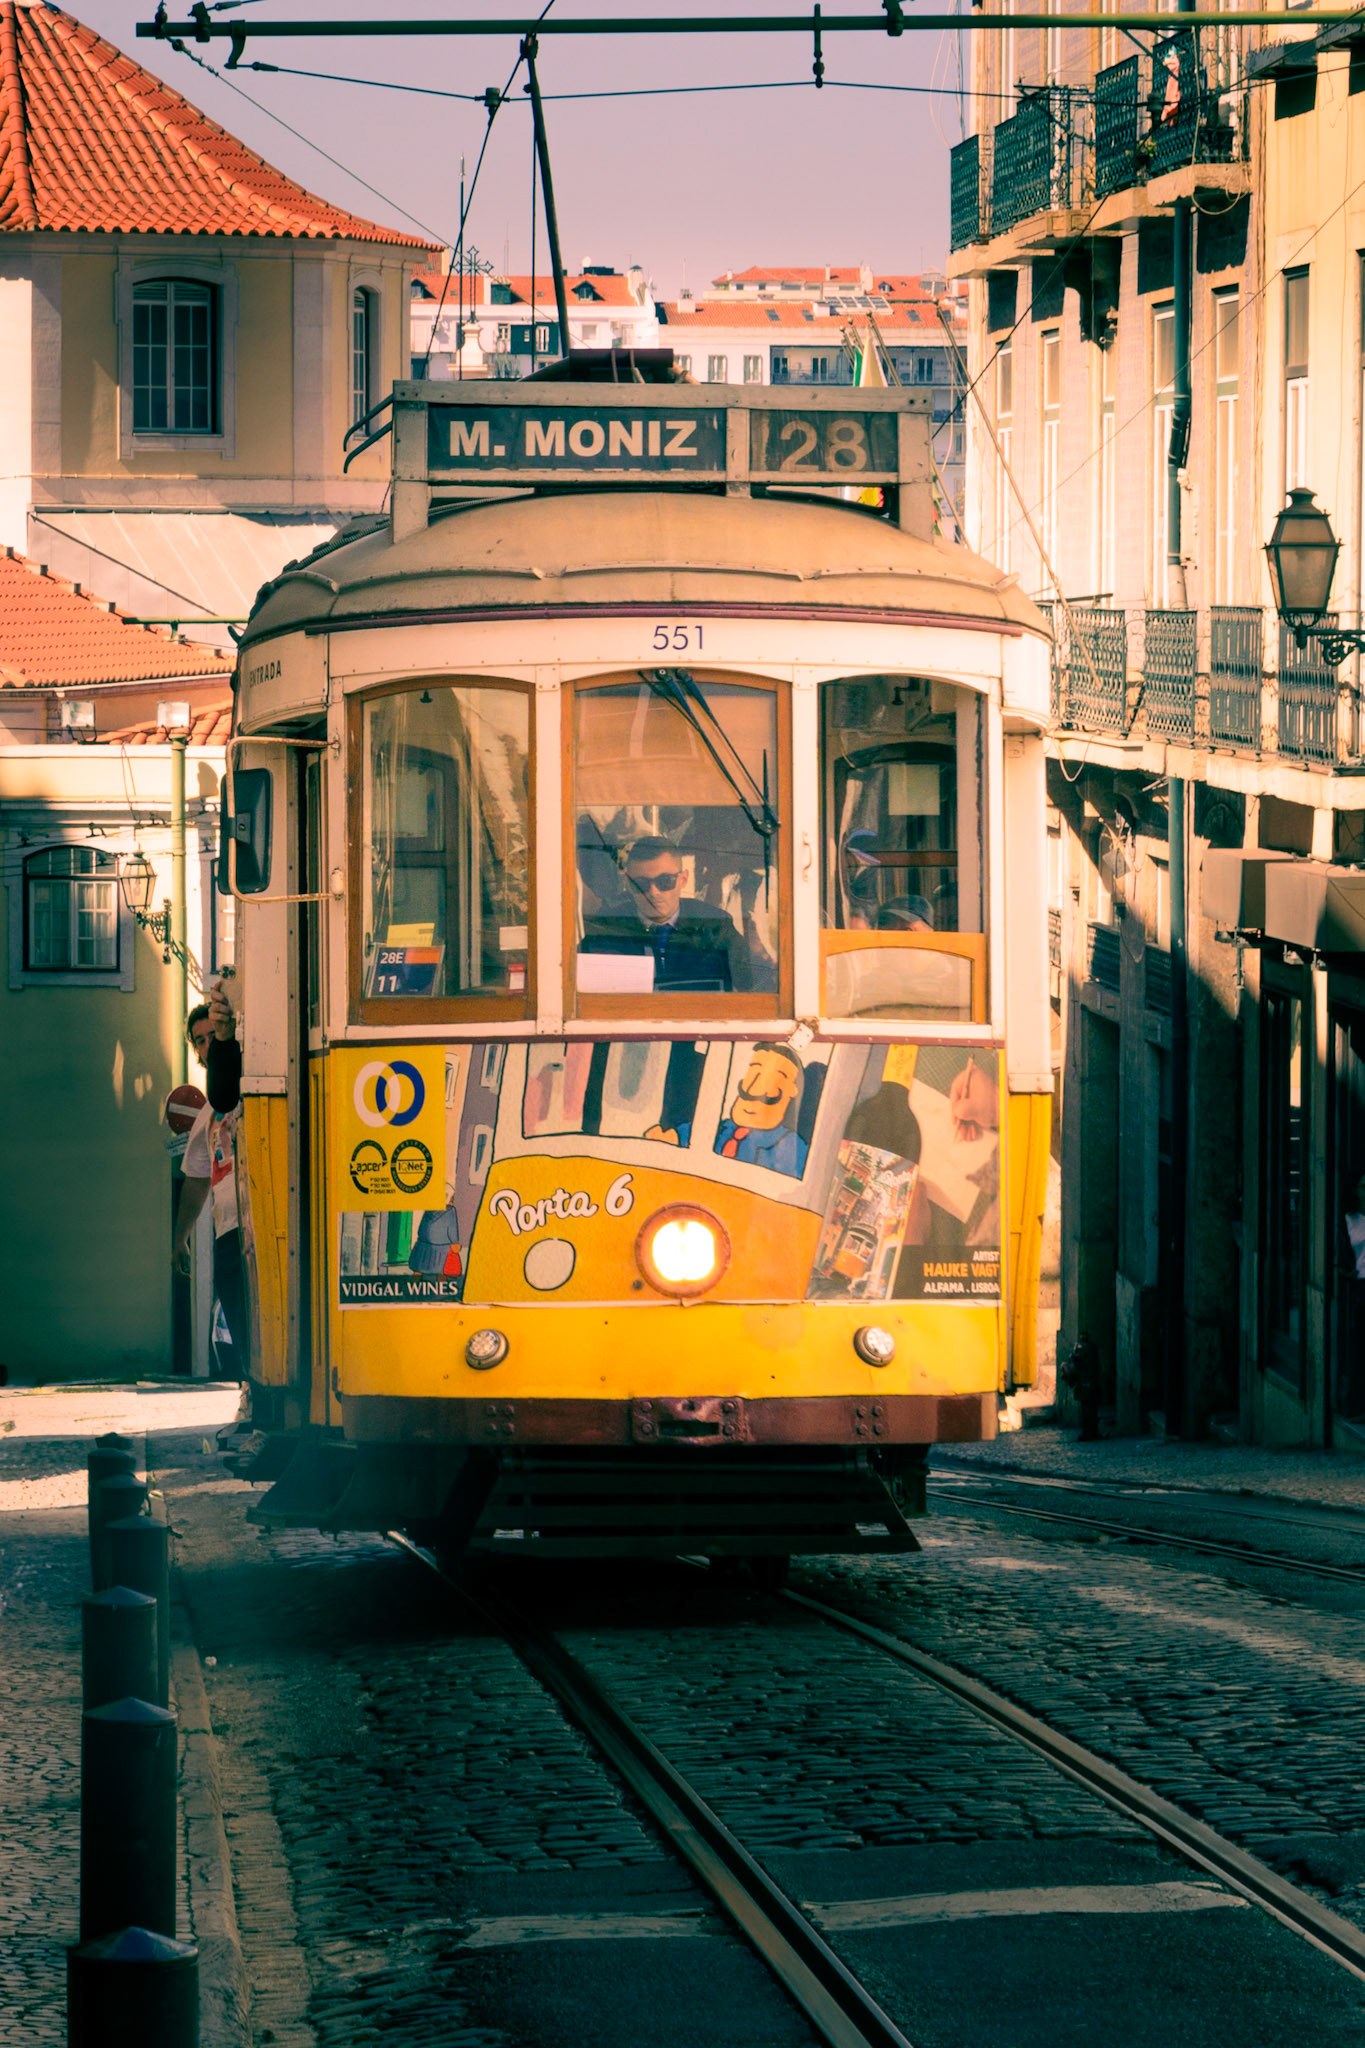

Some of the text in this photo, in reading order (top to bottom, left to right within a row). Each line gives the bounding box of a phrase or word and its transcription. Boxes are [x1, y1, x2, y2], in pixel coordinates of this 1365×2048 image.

[449, 420, 698, 457] M. MONIZ
[780, 419, 868, 472] 28
[653, 625, 703, 650] 551
[380, 952, 404, 965] 28E
[378, 975, 398, 993] 11
[356, 1162, 382, 1175] apcer
[398, 1162, 424, 1173] IQNet
[489, 1172, 634, 1236] Porta 6
[972, 1250, 1000, 1262] ARTIST
[923, 1262, 1001, 1278] HAUKE VAGT
[341, 1281, 459, 1297] VIDIGAL WINES
[923, 1282, 966, 1294] ALFAMA
[970, 1282, 1000, 1294] LISBOA
